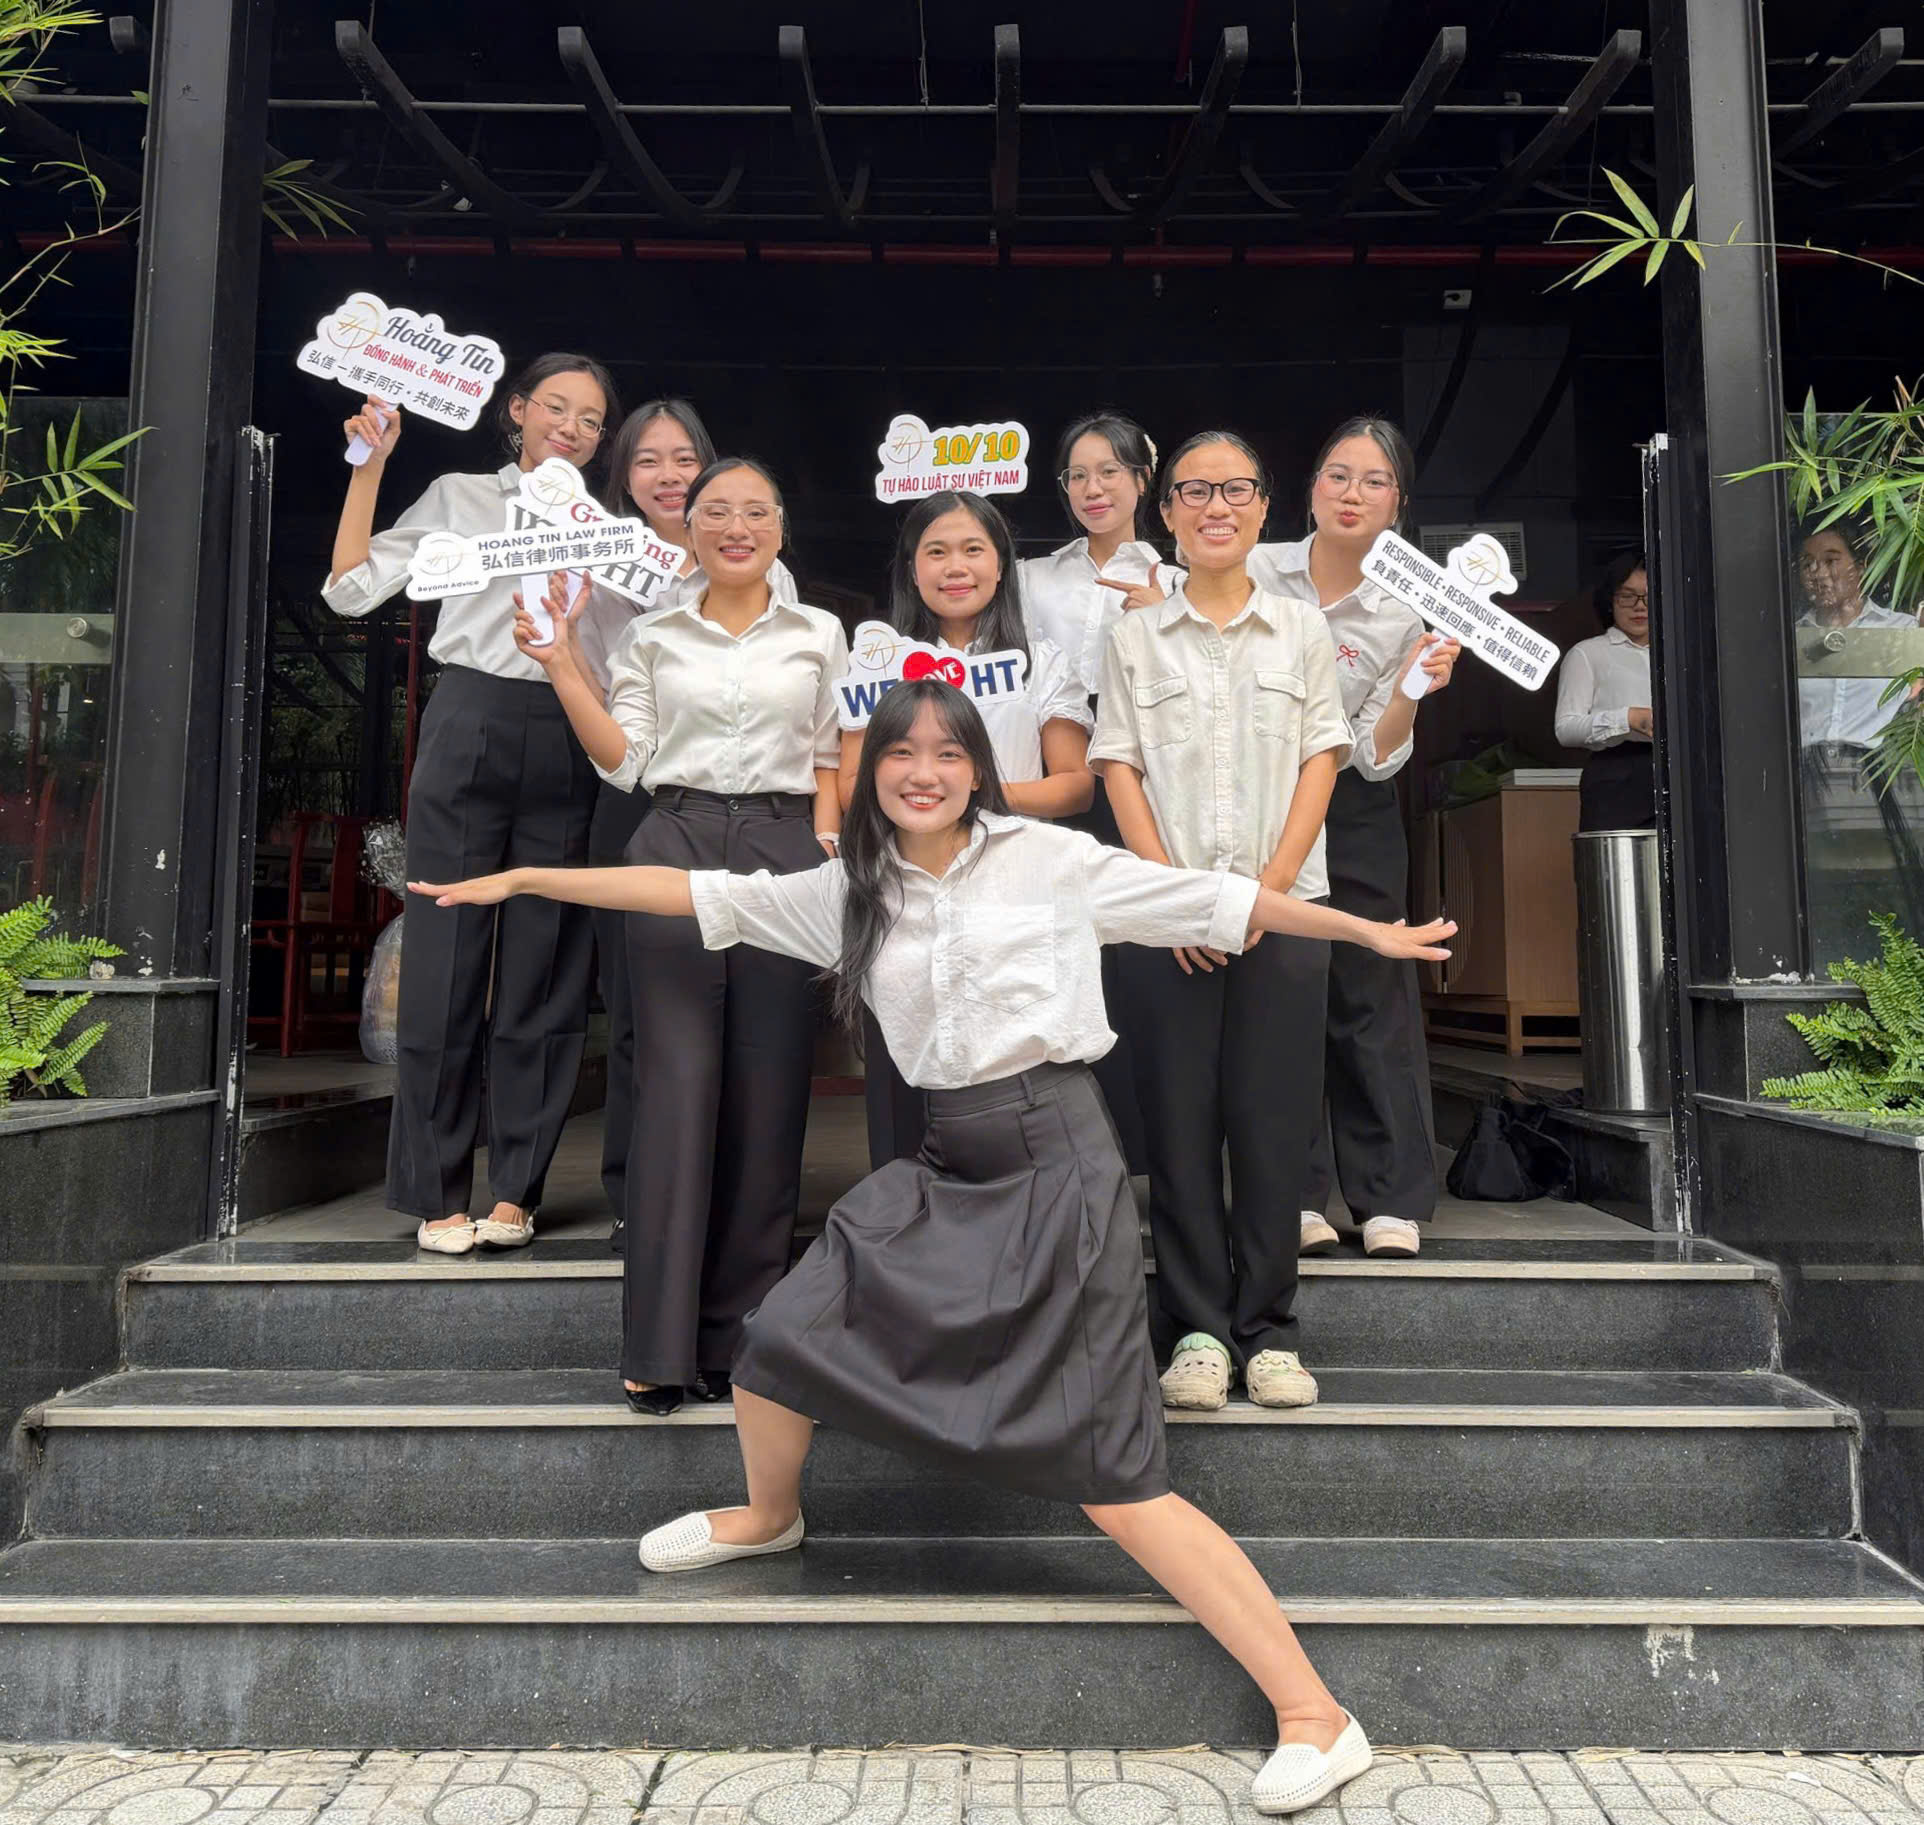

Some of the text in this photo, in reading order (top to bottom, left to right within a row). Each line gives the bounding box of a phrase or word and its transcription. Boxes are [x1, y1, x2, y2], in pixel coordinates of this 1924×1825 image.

[389, 353, 416, 372] HÀNH
[415, 363, 428, 377] &
[429, 368, 456, 387] PHÁT
[933, 430, 1020, 466] 10/10
[883, 478, 897, 496] TỰ
[898, 475, 919, 492] HÀO
[968, 470, 991, 489] VIỆT
[994, 470, 1019, 485] NAM
[478, 525, 634, 551] HOANG TIN LAW FIRM
[482, 538, 634, 570] 弘信律师事务所
[418, 579, 480, 593] Beyond Advice
[1505, 626, 1550, 663] RELIABLE
[970, 659, 1018, 698] HT
